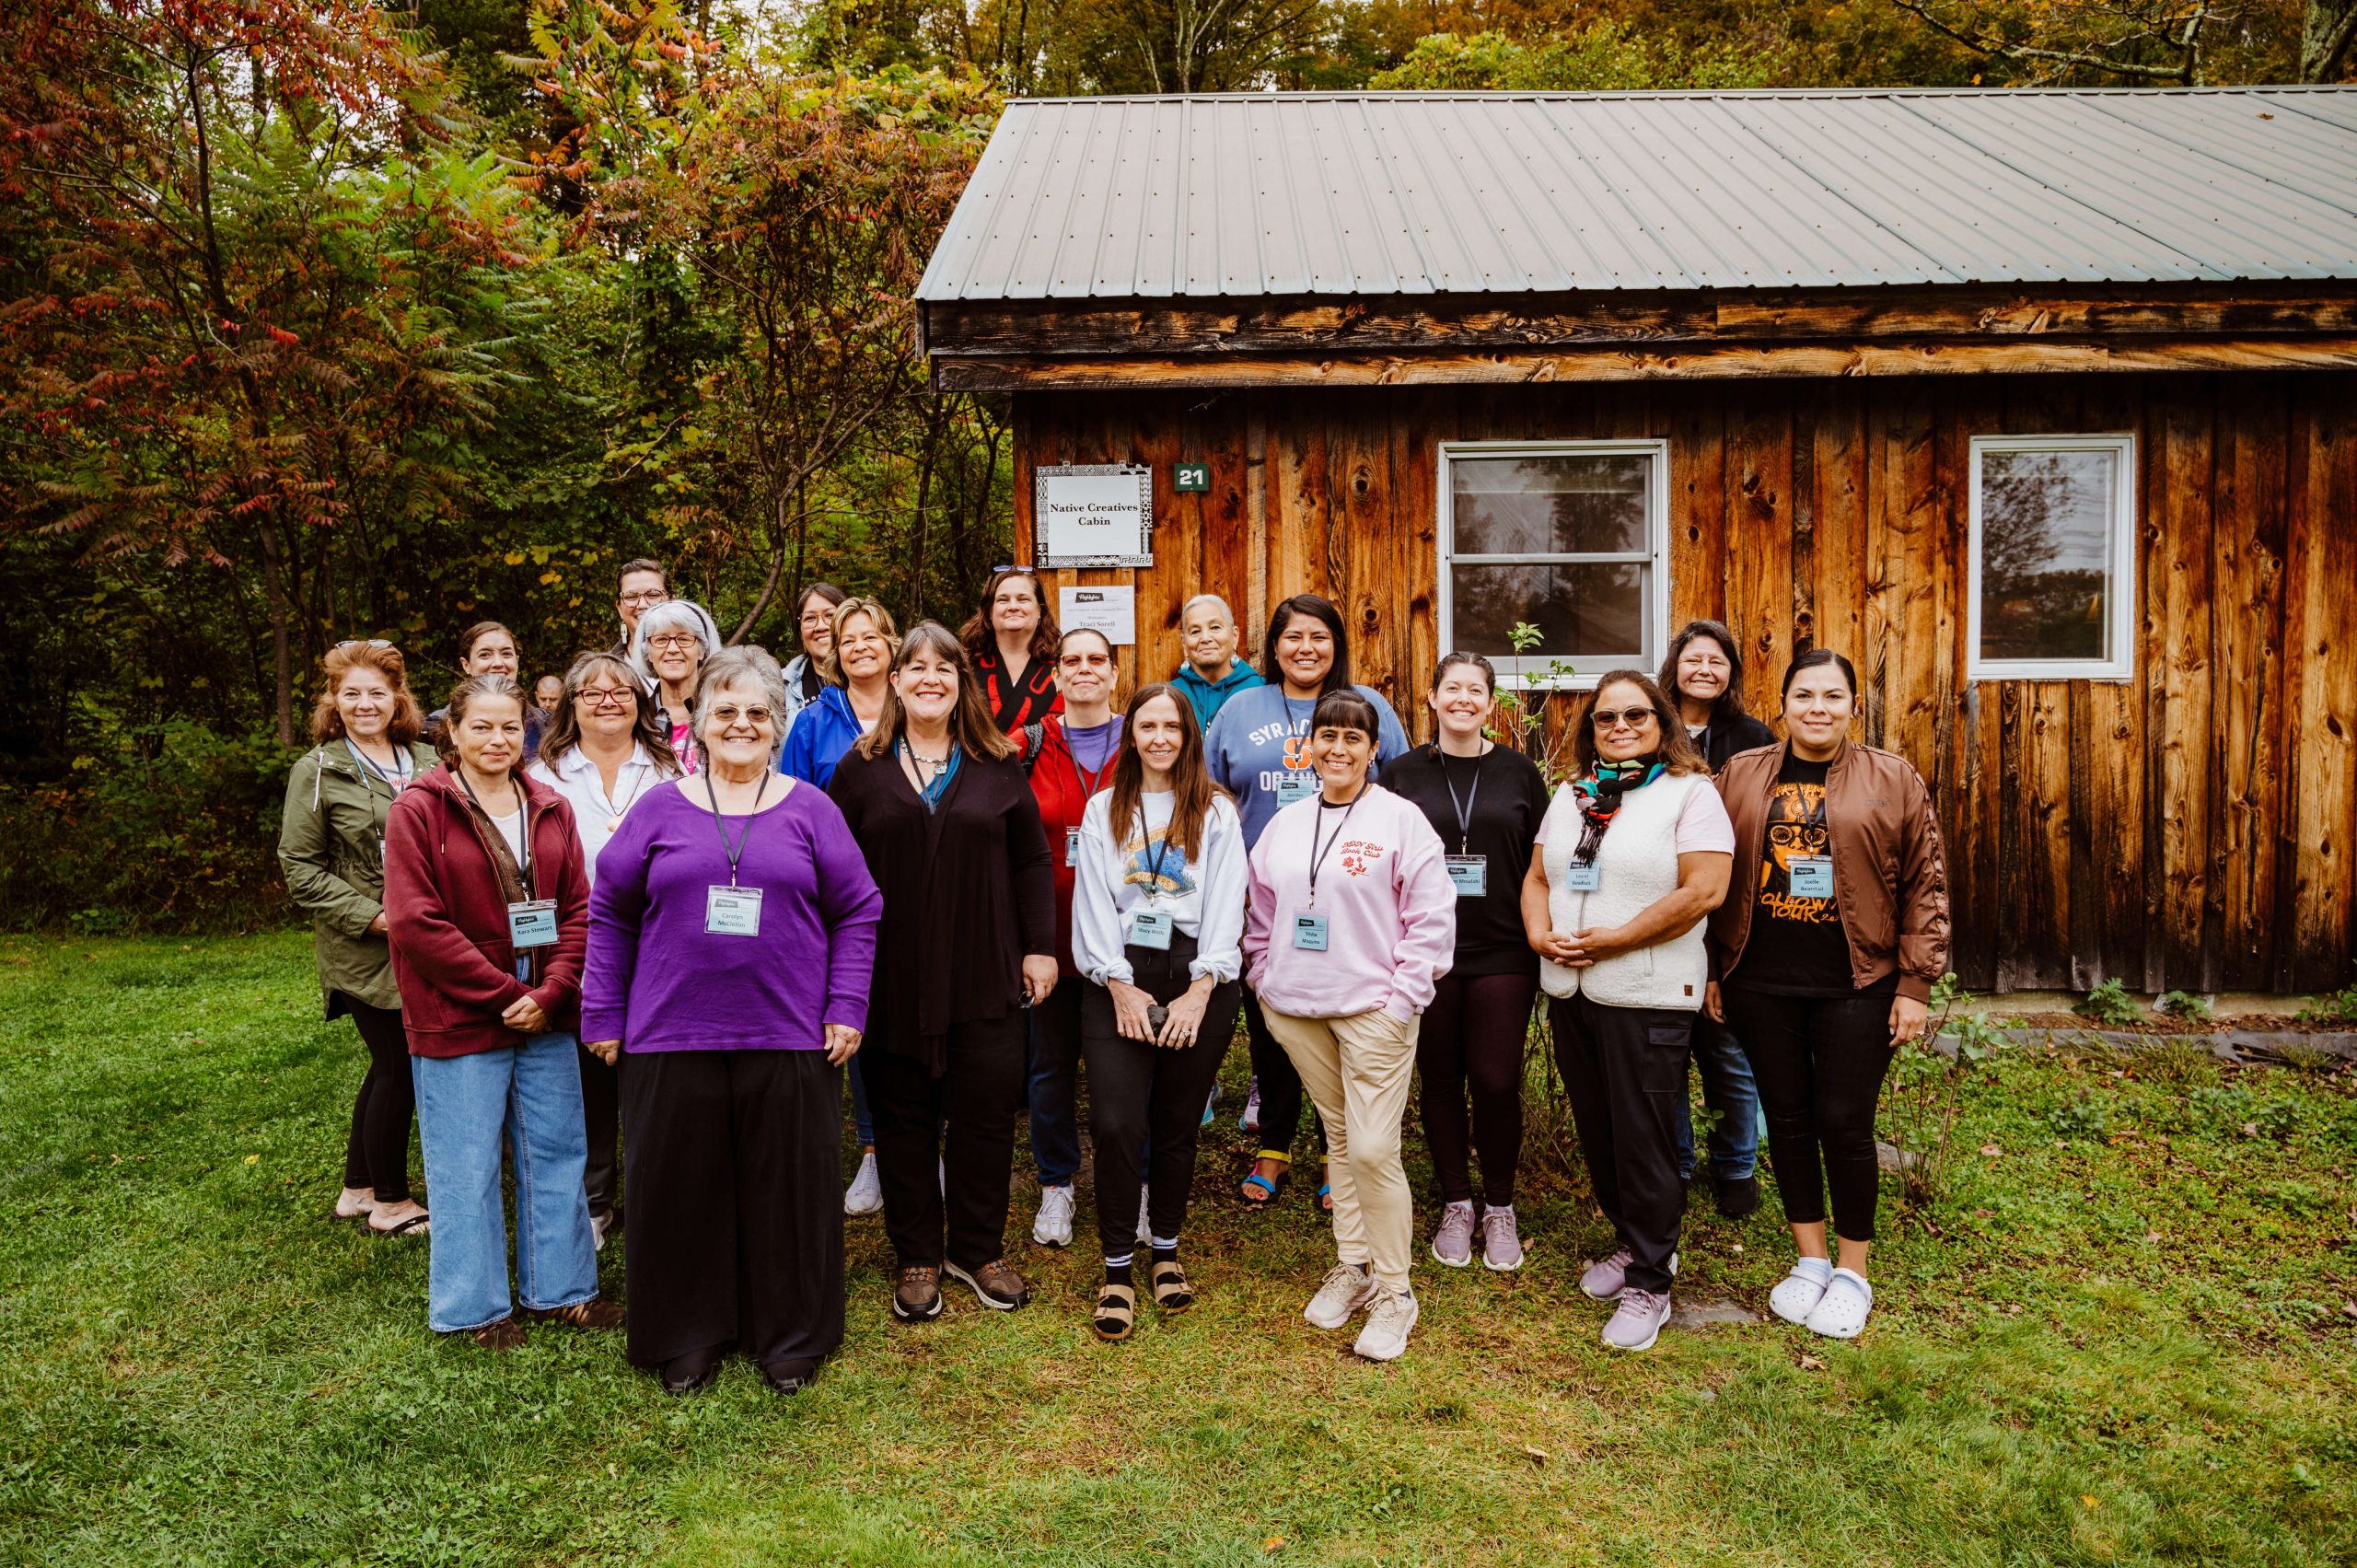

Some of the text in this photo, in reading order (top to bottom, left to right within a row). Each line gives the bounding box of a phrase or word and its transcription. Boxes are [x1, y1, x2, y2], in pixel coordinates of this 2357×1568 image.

[1179, 470, 1203, 485] 21
[1051, 503, 1138, 513] Native Creatives
[1078, 517, 1111, 526] Cabin
[1248, 718, 1311, 746] SYRAC
[1283, 737, 1314, 770] S
[1365, 842, 1384, 852] Girls
[1364, 850, 1381, 858] Club
[1768, 901, 1820, 923] TOUR
[717, 920, 746, 928] McClellan
[530, 925, 552, 934] Stewart
